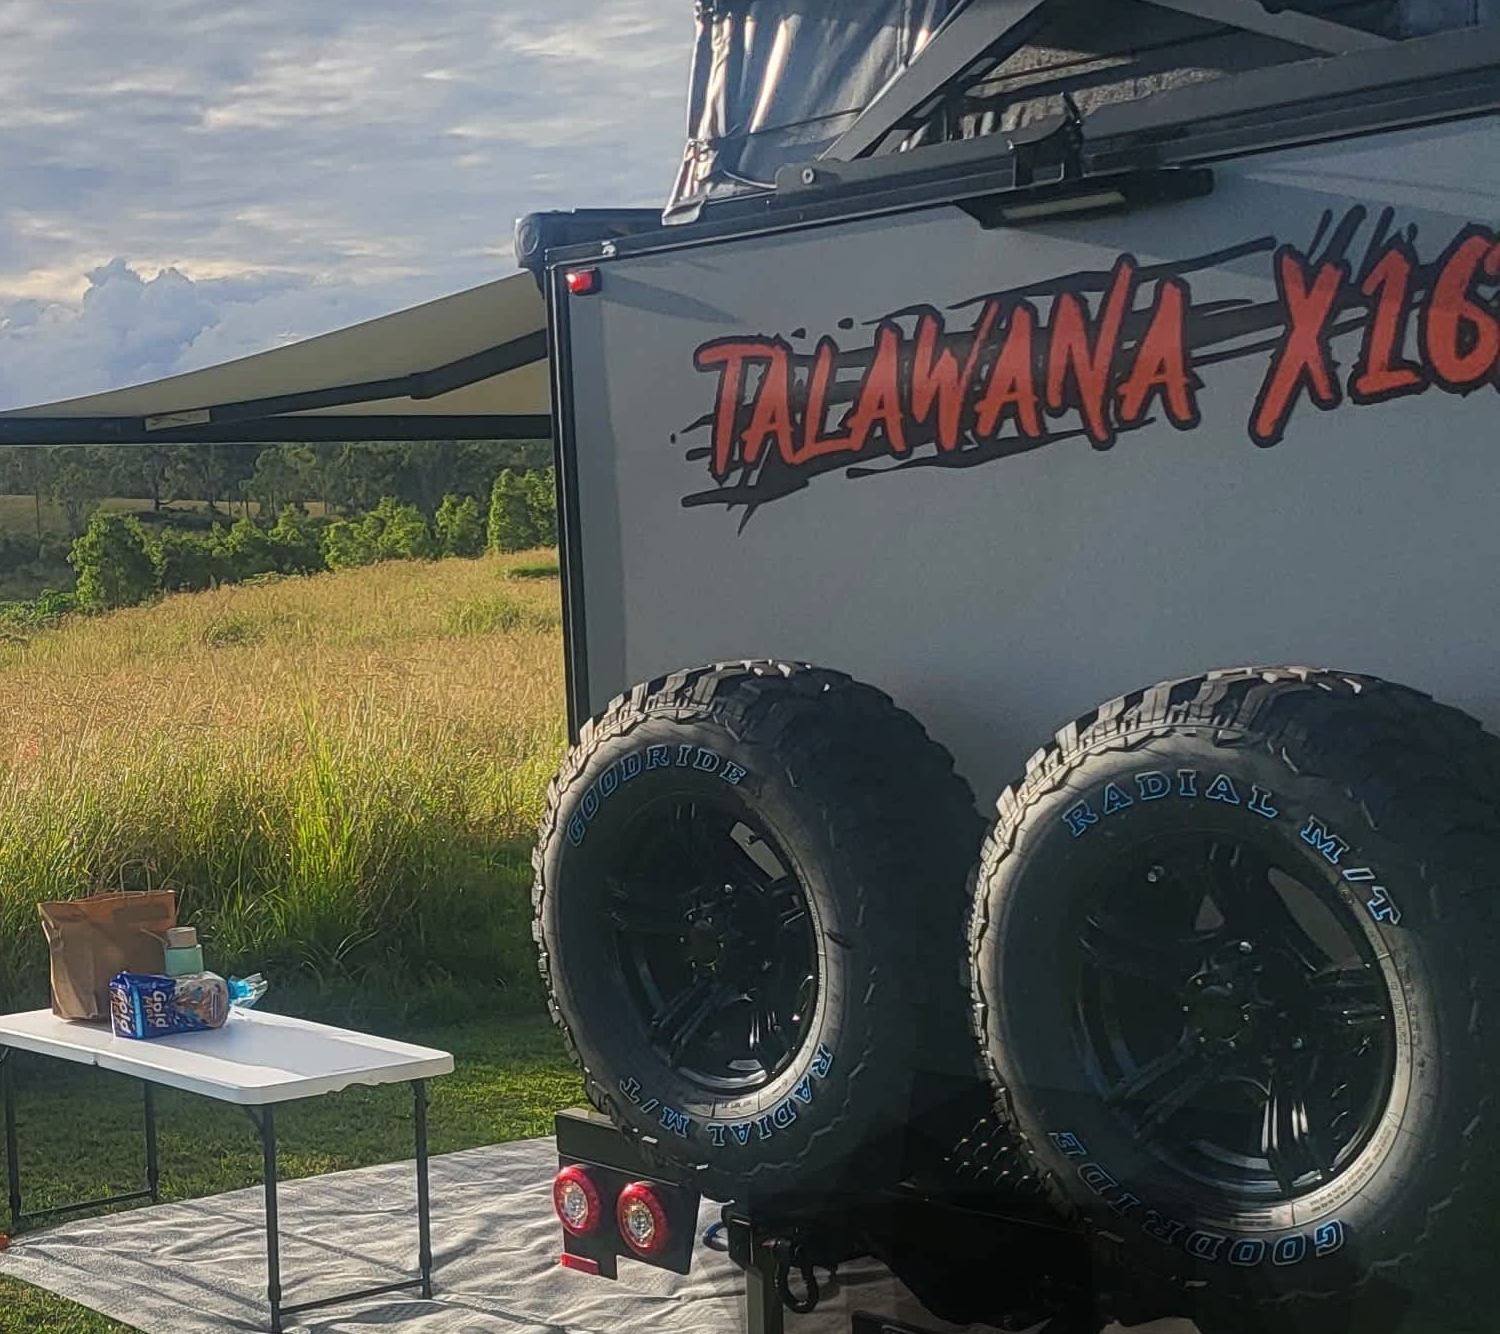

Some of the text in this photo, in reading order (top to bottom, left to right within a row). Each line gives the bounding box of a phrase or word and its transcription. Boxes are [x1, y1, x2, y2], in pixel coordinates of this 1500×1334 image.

[695, 231, 1500, 479] TALAWANA X16
[567, 744, 747, 847] GOODRIDE
[1061, 768, 1402, 926] RADIAL M/T
[116, 988, 132, 1034] Gold
[153, 990, 169, 1027] Gold
[619, 1042, 834, 1147] RADIAL M/T
[1048, 1132, 1345, 1267] GOODRIDE
